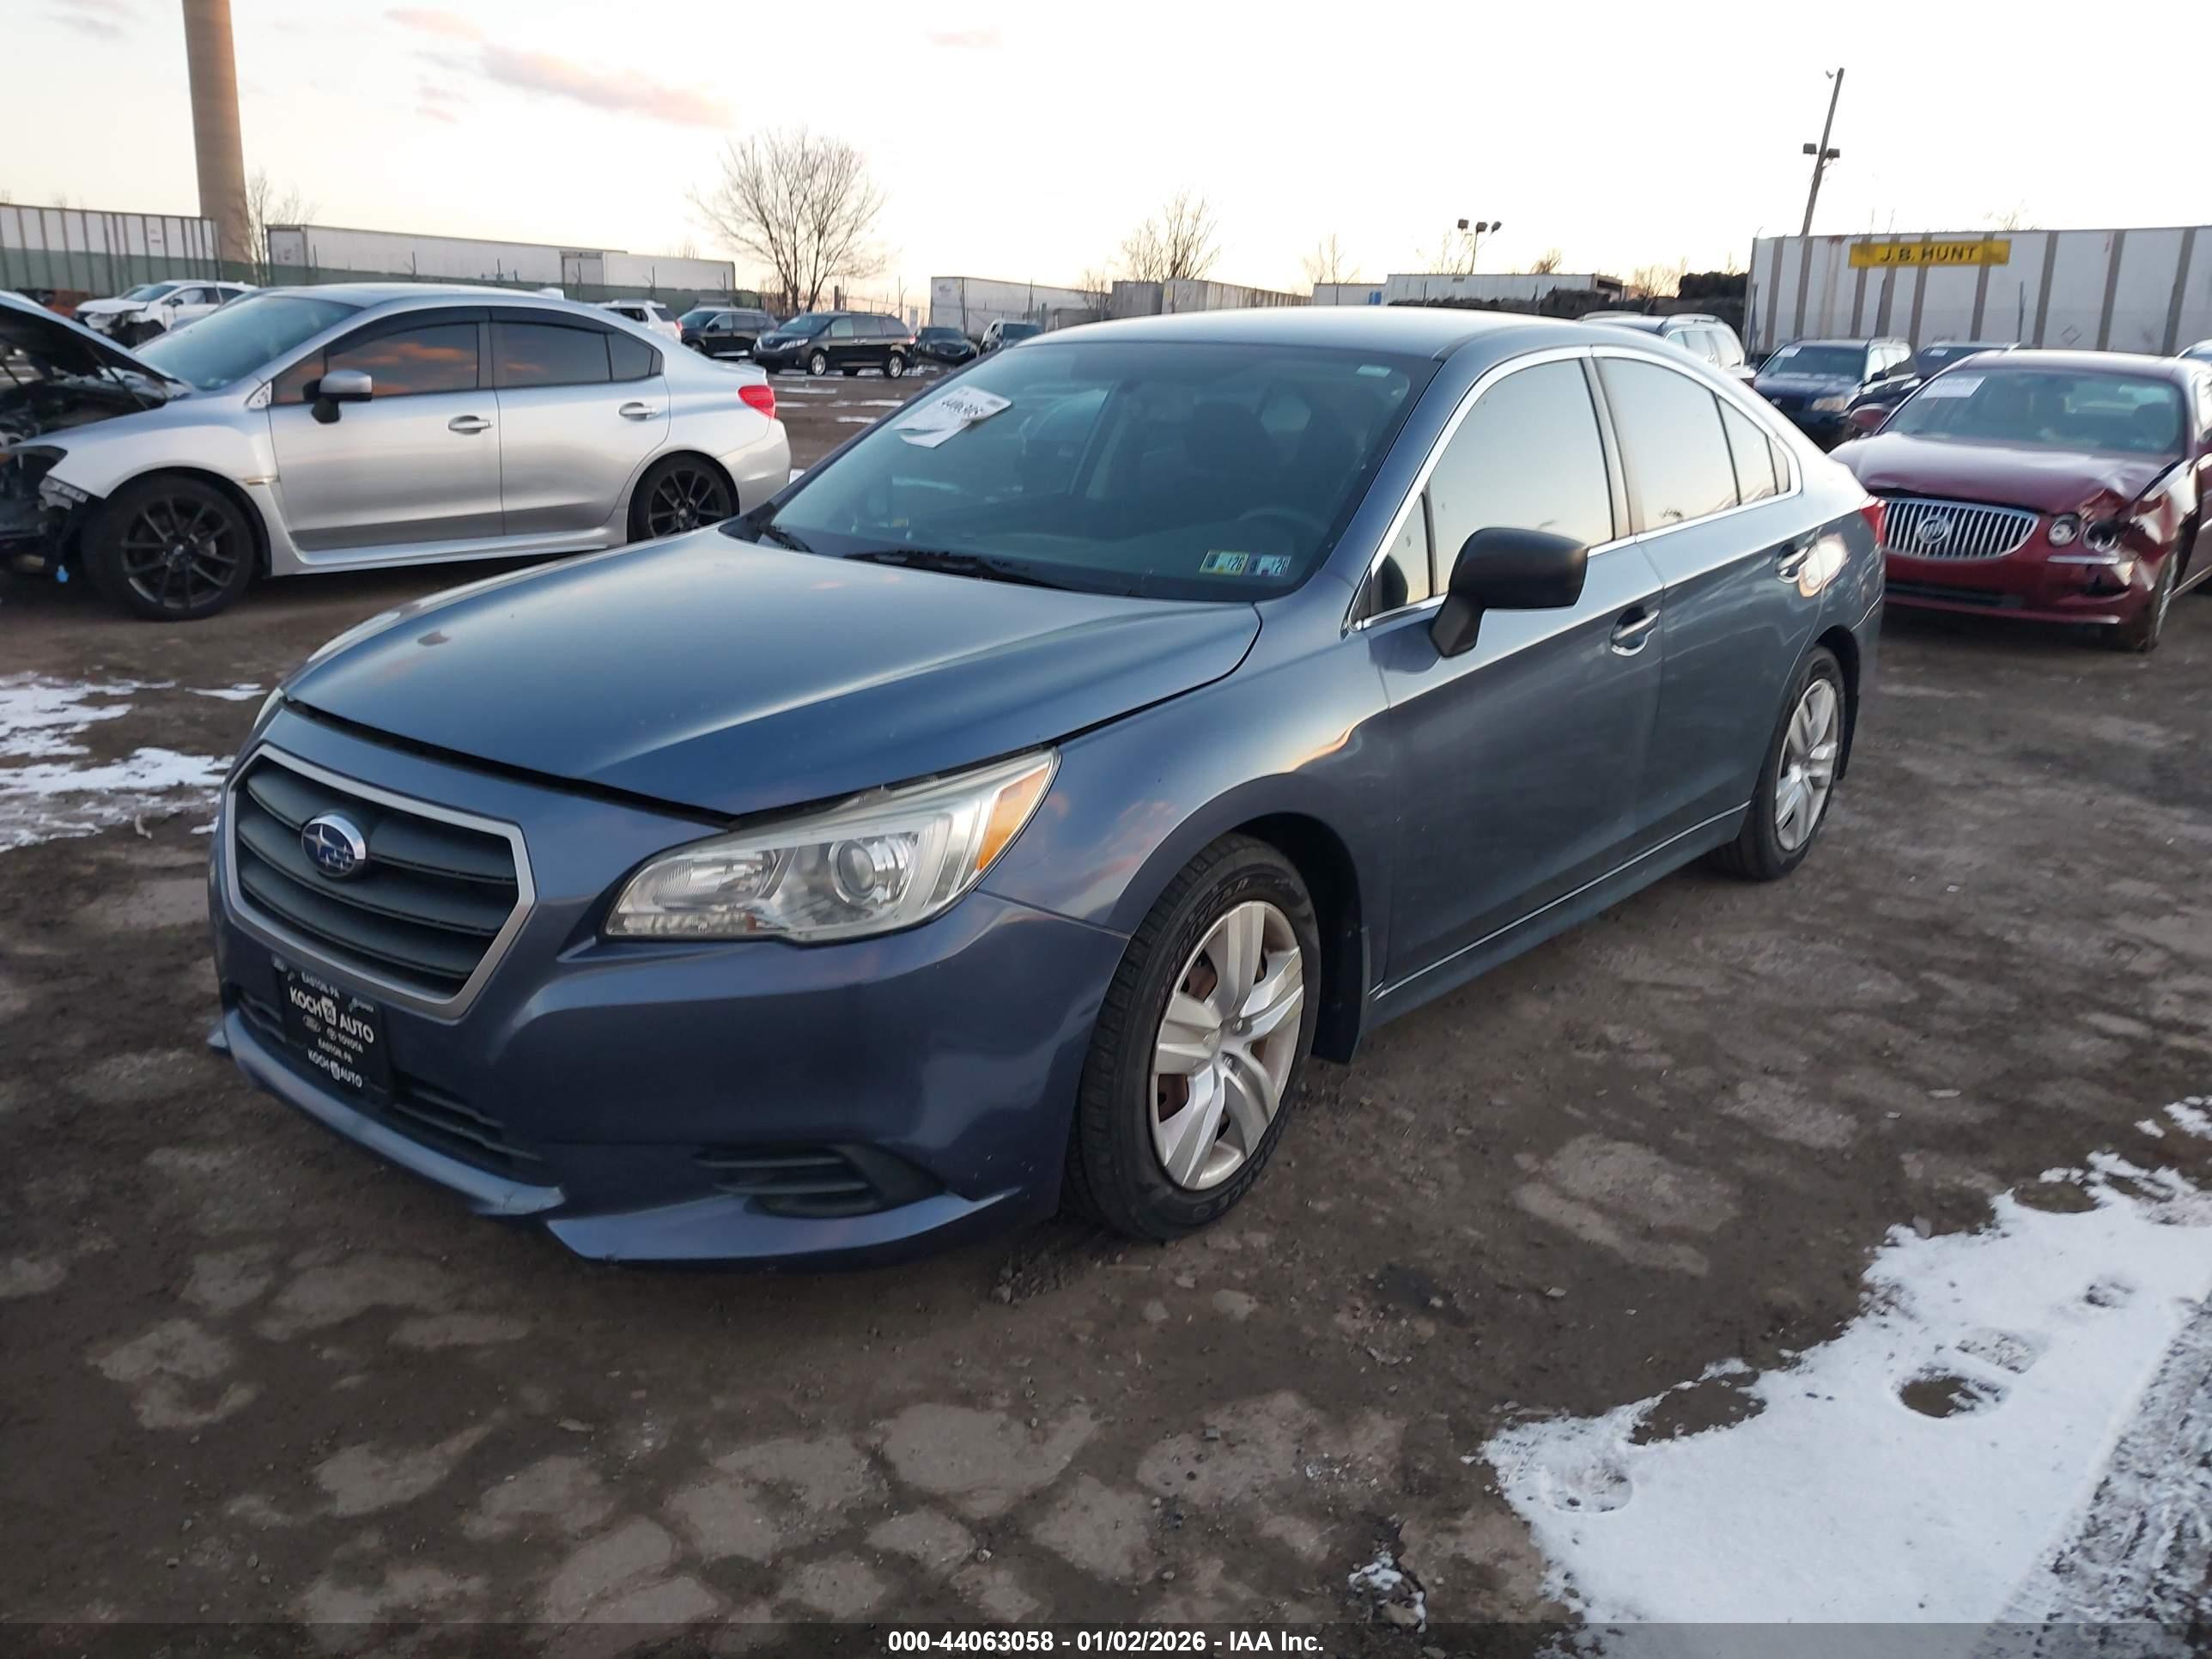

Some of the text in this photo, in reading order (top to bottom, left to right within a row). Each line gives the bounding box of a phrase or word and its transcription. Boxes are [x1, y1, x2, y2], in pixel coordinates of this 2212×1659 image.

[1921, 245, 1978, 261] HUNT
[289, 986, 323, 1018] KOCH
[339, 1013, 374, 1044] AUTO
[307, 1048, 330, 1072] KOCH
[340, 1066, 362, 1088] AUTO
